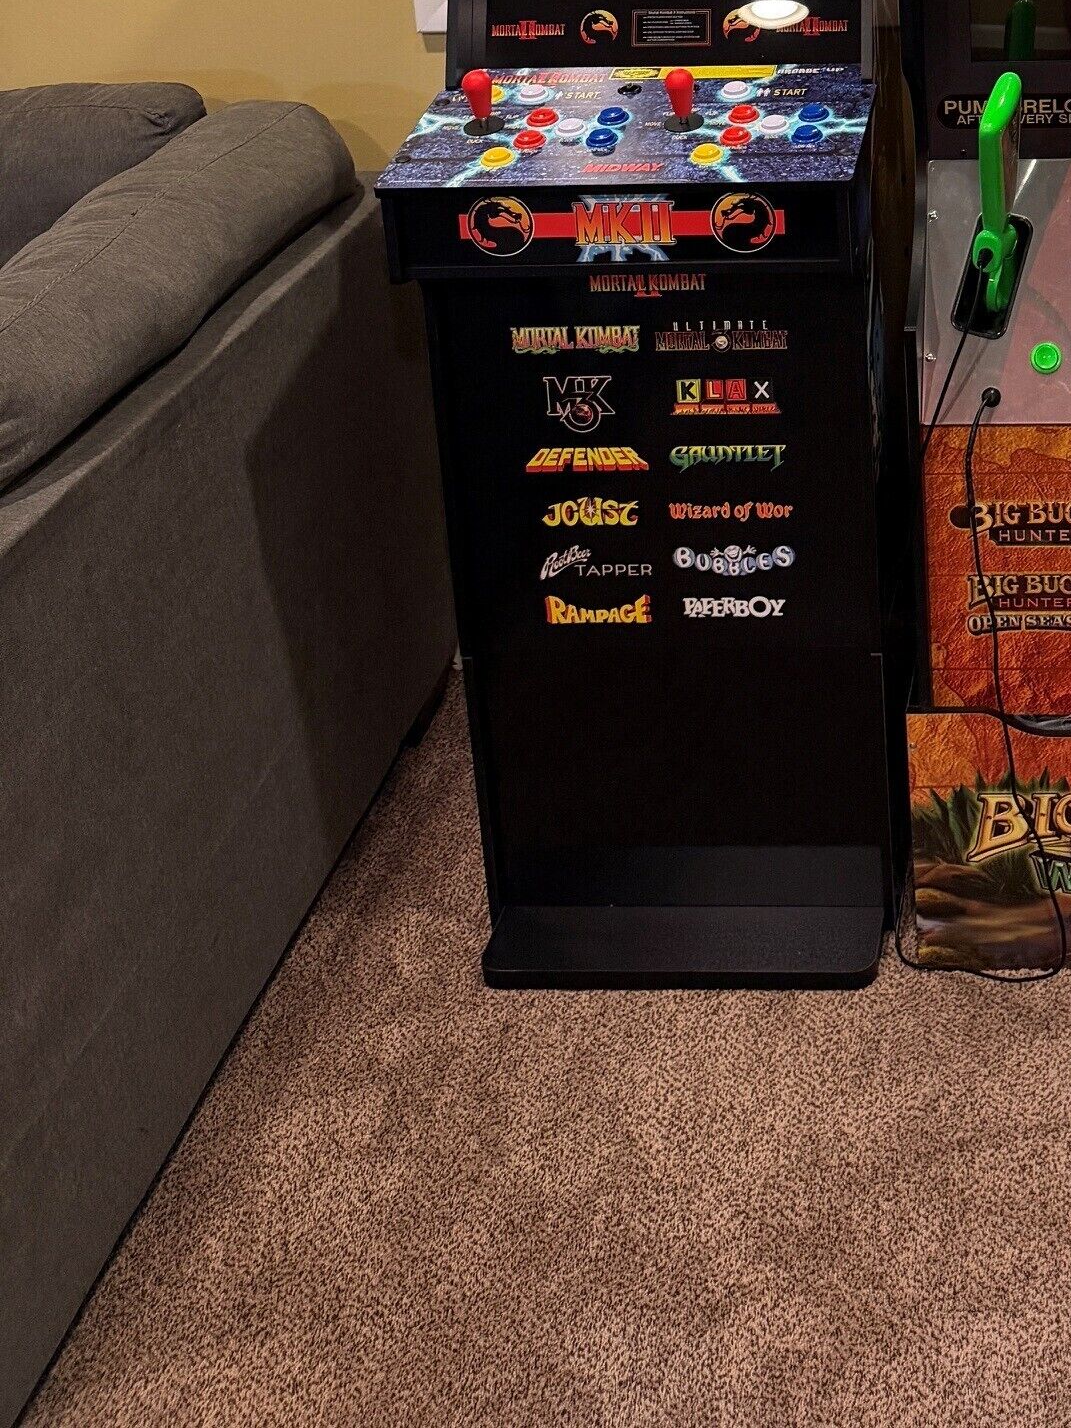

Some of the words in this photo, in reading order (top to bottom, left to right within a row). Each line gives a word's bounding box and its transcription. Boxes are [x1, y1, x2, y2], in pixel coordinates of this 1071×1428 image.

[492, 24, 528, 36] MORTAL
[566, 91, 601, 99] START
[773, 88, 807, 96] START
[944, 99, 988, 115] PUM
[1020, 114, 1053, 124] VERY
[582, 163, 664, 172] MIDWAY
[572, 202, 677, 245] MKII
[589, 274, 646, 292] MORTAL
[648, 273, 707, 291] KOMBAT
[672, 320, 769, 331] ULTIMATE
[510, 327, 573, 353] MORTAL
[573, 325, 641, 352] KOMBAT
[677, 379, 771, 403] KLAX
[526, 447, 649, 472] DEFENDER
[669, 444, 787, 472] GAUNTLET
[542, 496, 639, 526] JOUST
[669, 502, 730, 519] Wizard
[733, 501, 754, 522] of
[755, 502, 793, 519] Wor
[574, 563, 652, 576] TAPPER
[672, 546, 795, 575] BUBBLES
[968, 575, 1021, 609] BIG
[545, 594, 652, 623] RAMPAGE
[683, 596, 786, 618] PAPERBOY
[968, 614, 1022, 634] OPEN
